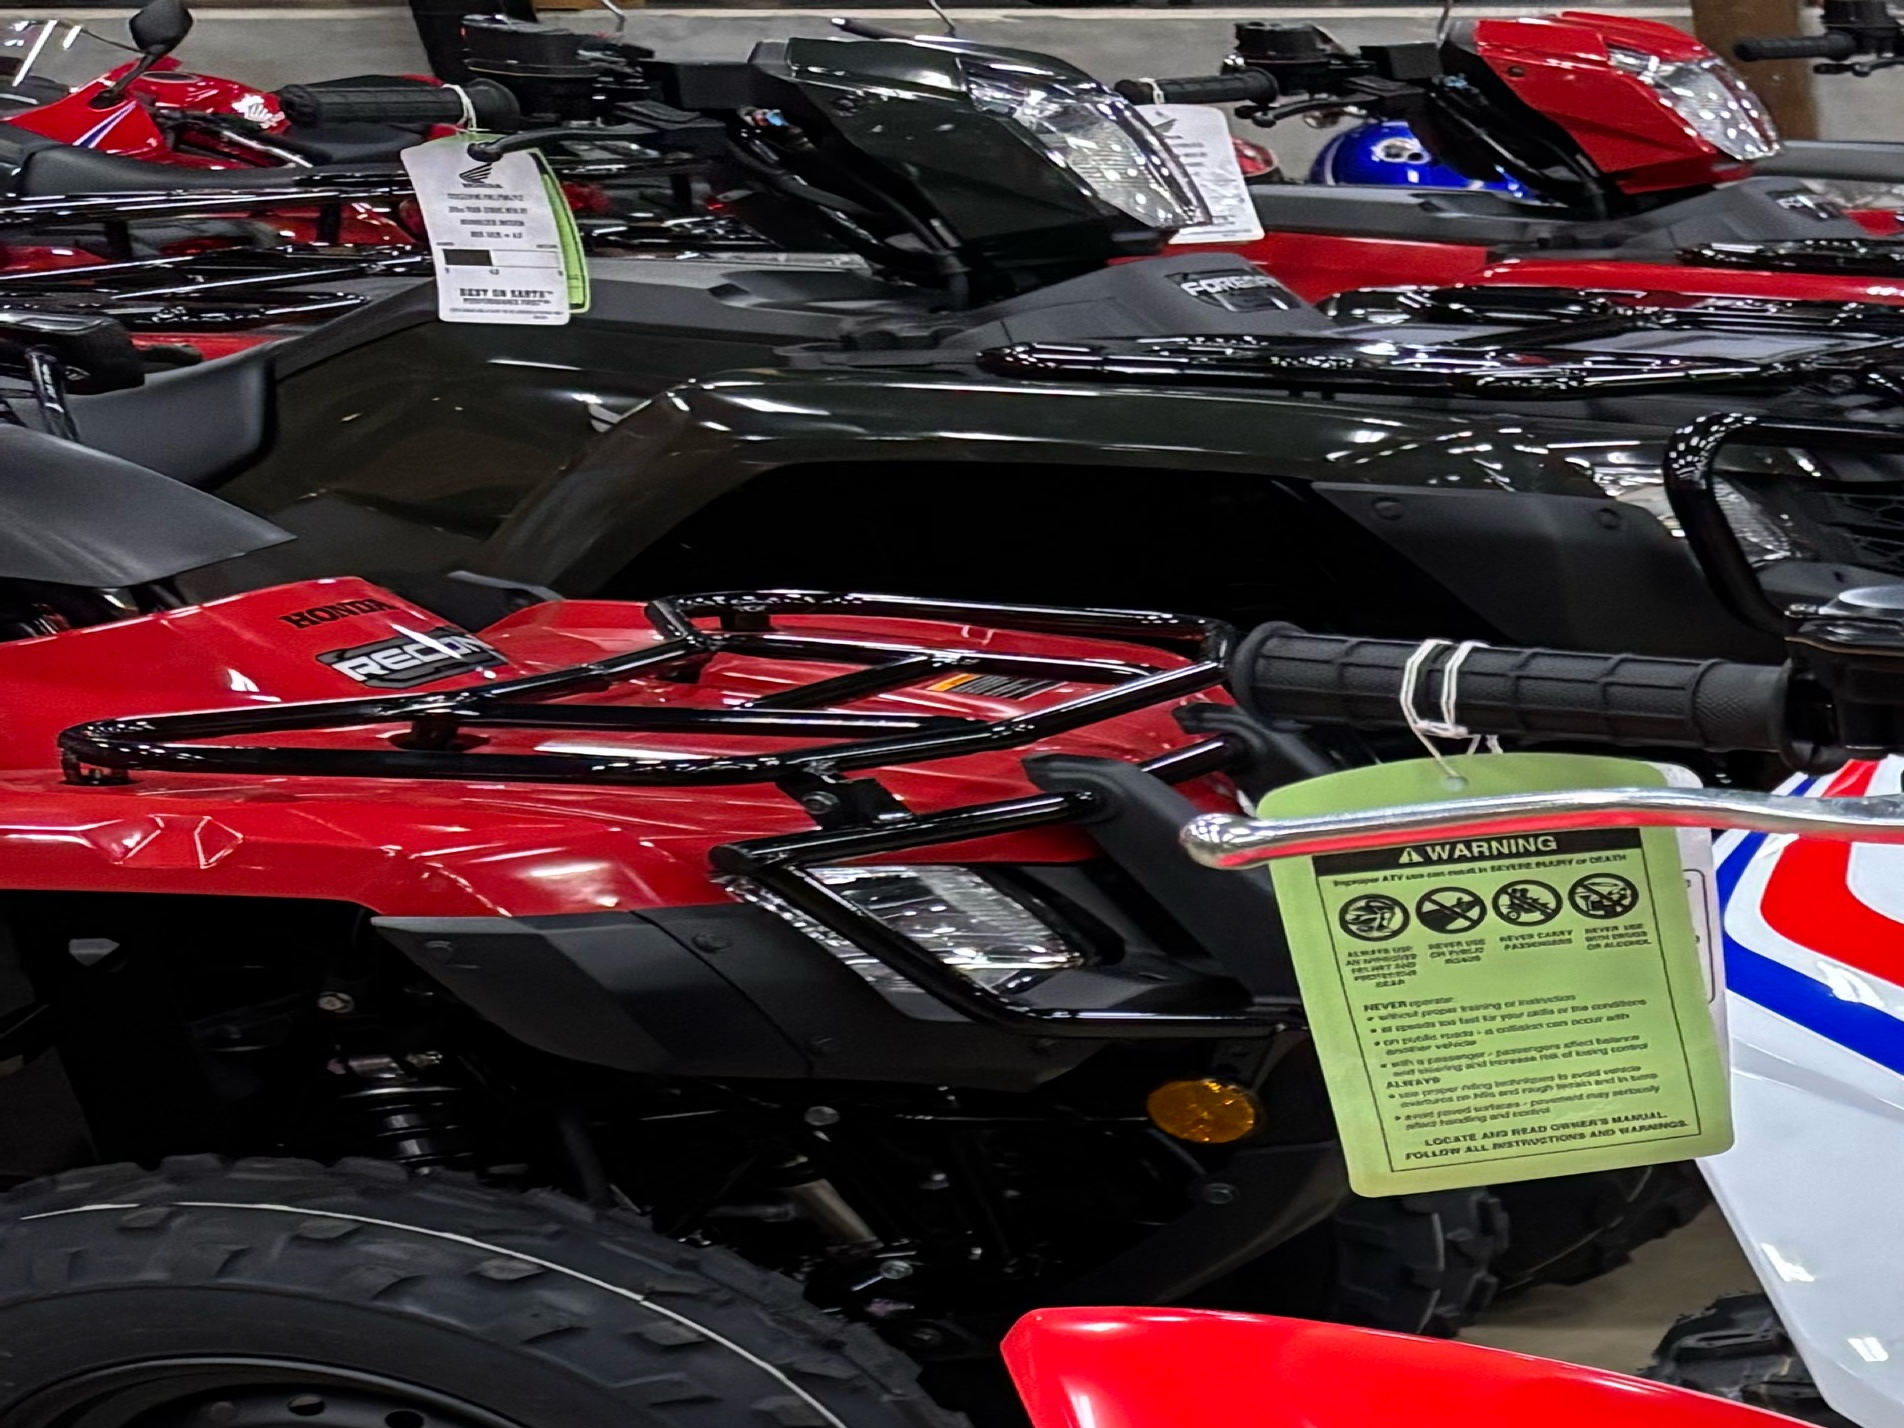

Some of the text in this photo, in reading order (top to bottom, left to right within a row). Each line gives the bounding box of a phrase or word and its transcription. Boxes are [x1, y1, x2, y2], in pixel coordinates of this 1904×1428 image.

[280, 598, 399, 629] HONDA
[331, 634, 492, 682] RECON
[1426, 836, 1557, 861] WARNING
[1381, 873, 1405, 883] ATV
[1489, 862, 1533, 874] SEVERE
[1589, 854, 1627, 865] DEATH
[1363, 1000, 1408, 1012] NEVER
[1403, 1146, 1461, 1160] FOLLOW
[1463, 1143, 1489, 1153] ALL
[1491, 1132, 1586, 1150] INSTRUCTIONS
[1588, 1128, 1616, 1138] AND
[1423, 1132, 1478, 1146] LOCATE
[1479, 1129, 1508, 1139] AND
[1510, 1124, 1547, 1136] READ
